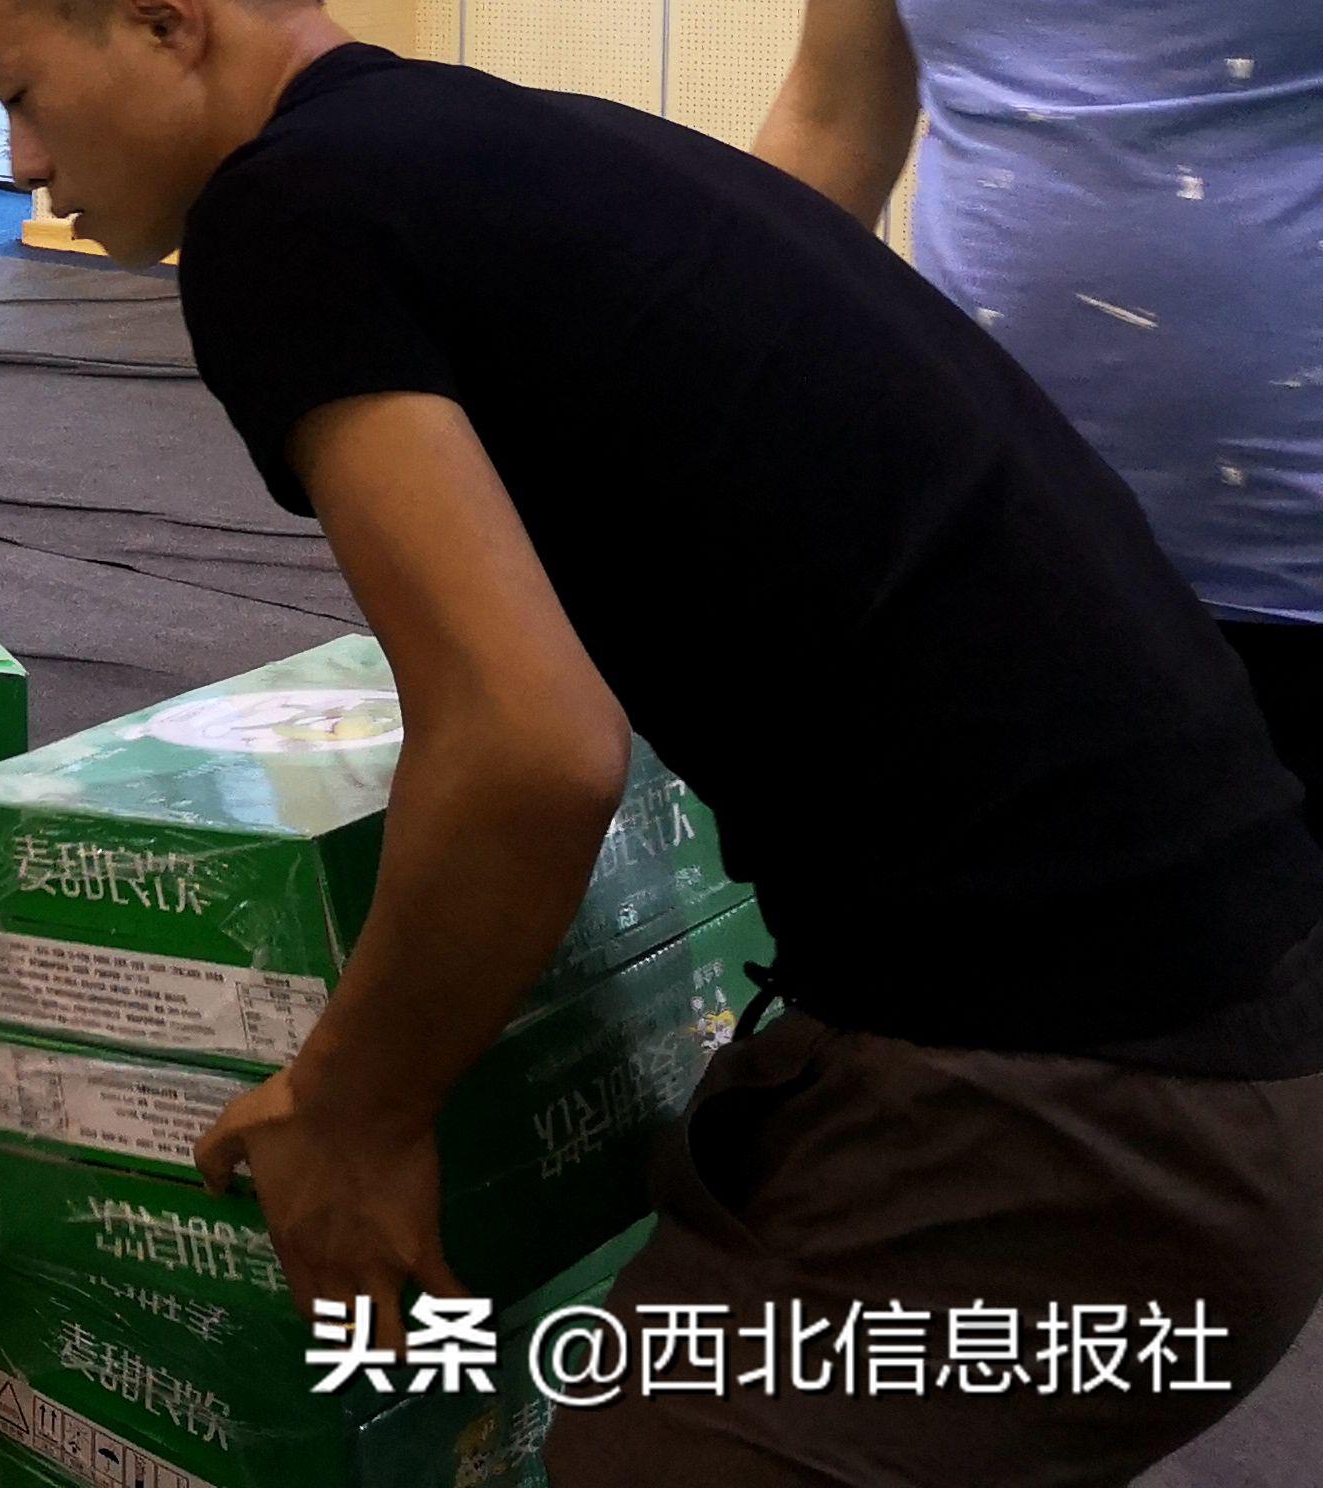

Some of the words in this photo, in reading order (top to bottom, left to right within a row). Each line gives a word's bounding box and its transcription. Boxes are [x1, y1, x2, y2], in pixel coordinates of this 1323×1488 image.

[14, 835, 213, 916] 麦甜良饮
[57, 1319, 231, 1452] 麦甜良饮
